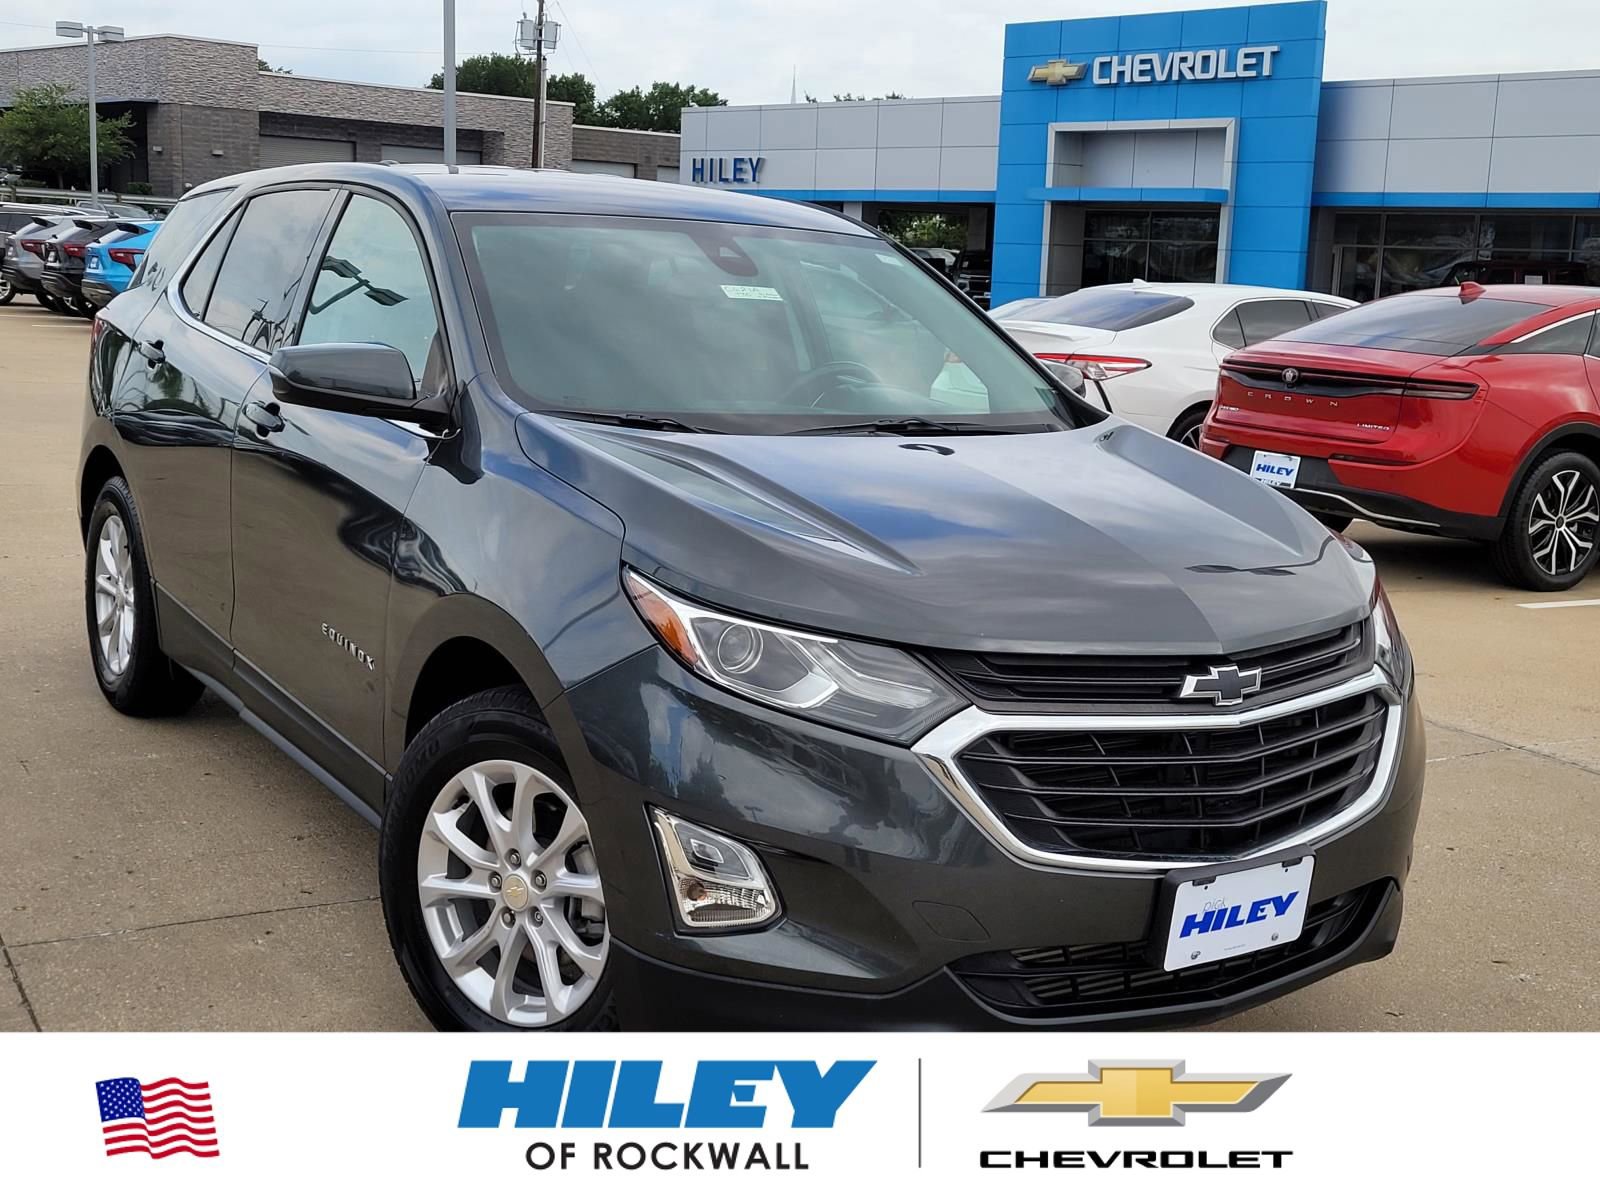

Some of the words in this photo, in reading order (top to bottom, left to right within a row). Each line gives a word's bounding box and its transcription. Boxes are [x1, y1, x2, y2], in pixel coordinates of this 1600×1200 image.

[1092, 45, 1280, 85] CHEVROLET
[692, 157, 764, 183] HILEY
[1247, 391, 1338, 407] CROWN
[1255, 463, 1294, 477] HILEY
[321, 622, 375, 671] EQUINOX
[1179, 891, 1299, 938] HILEY
